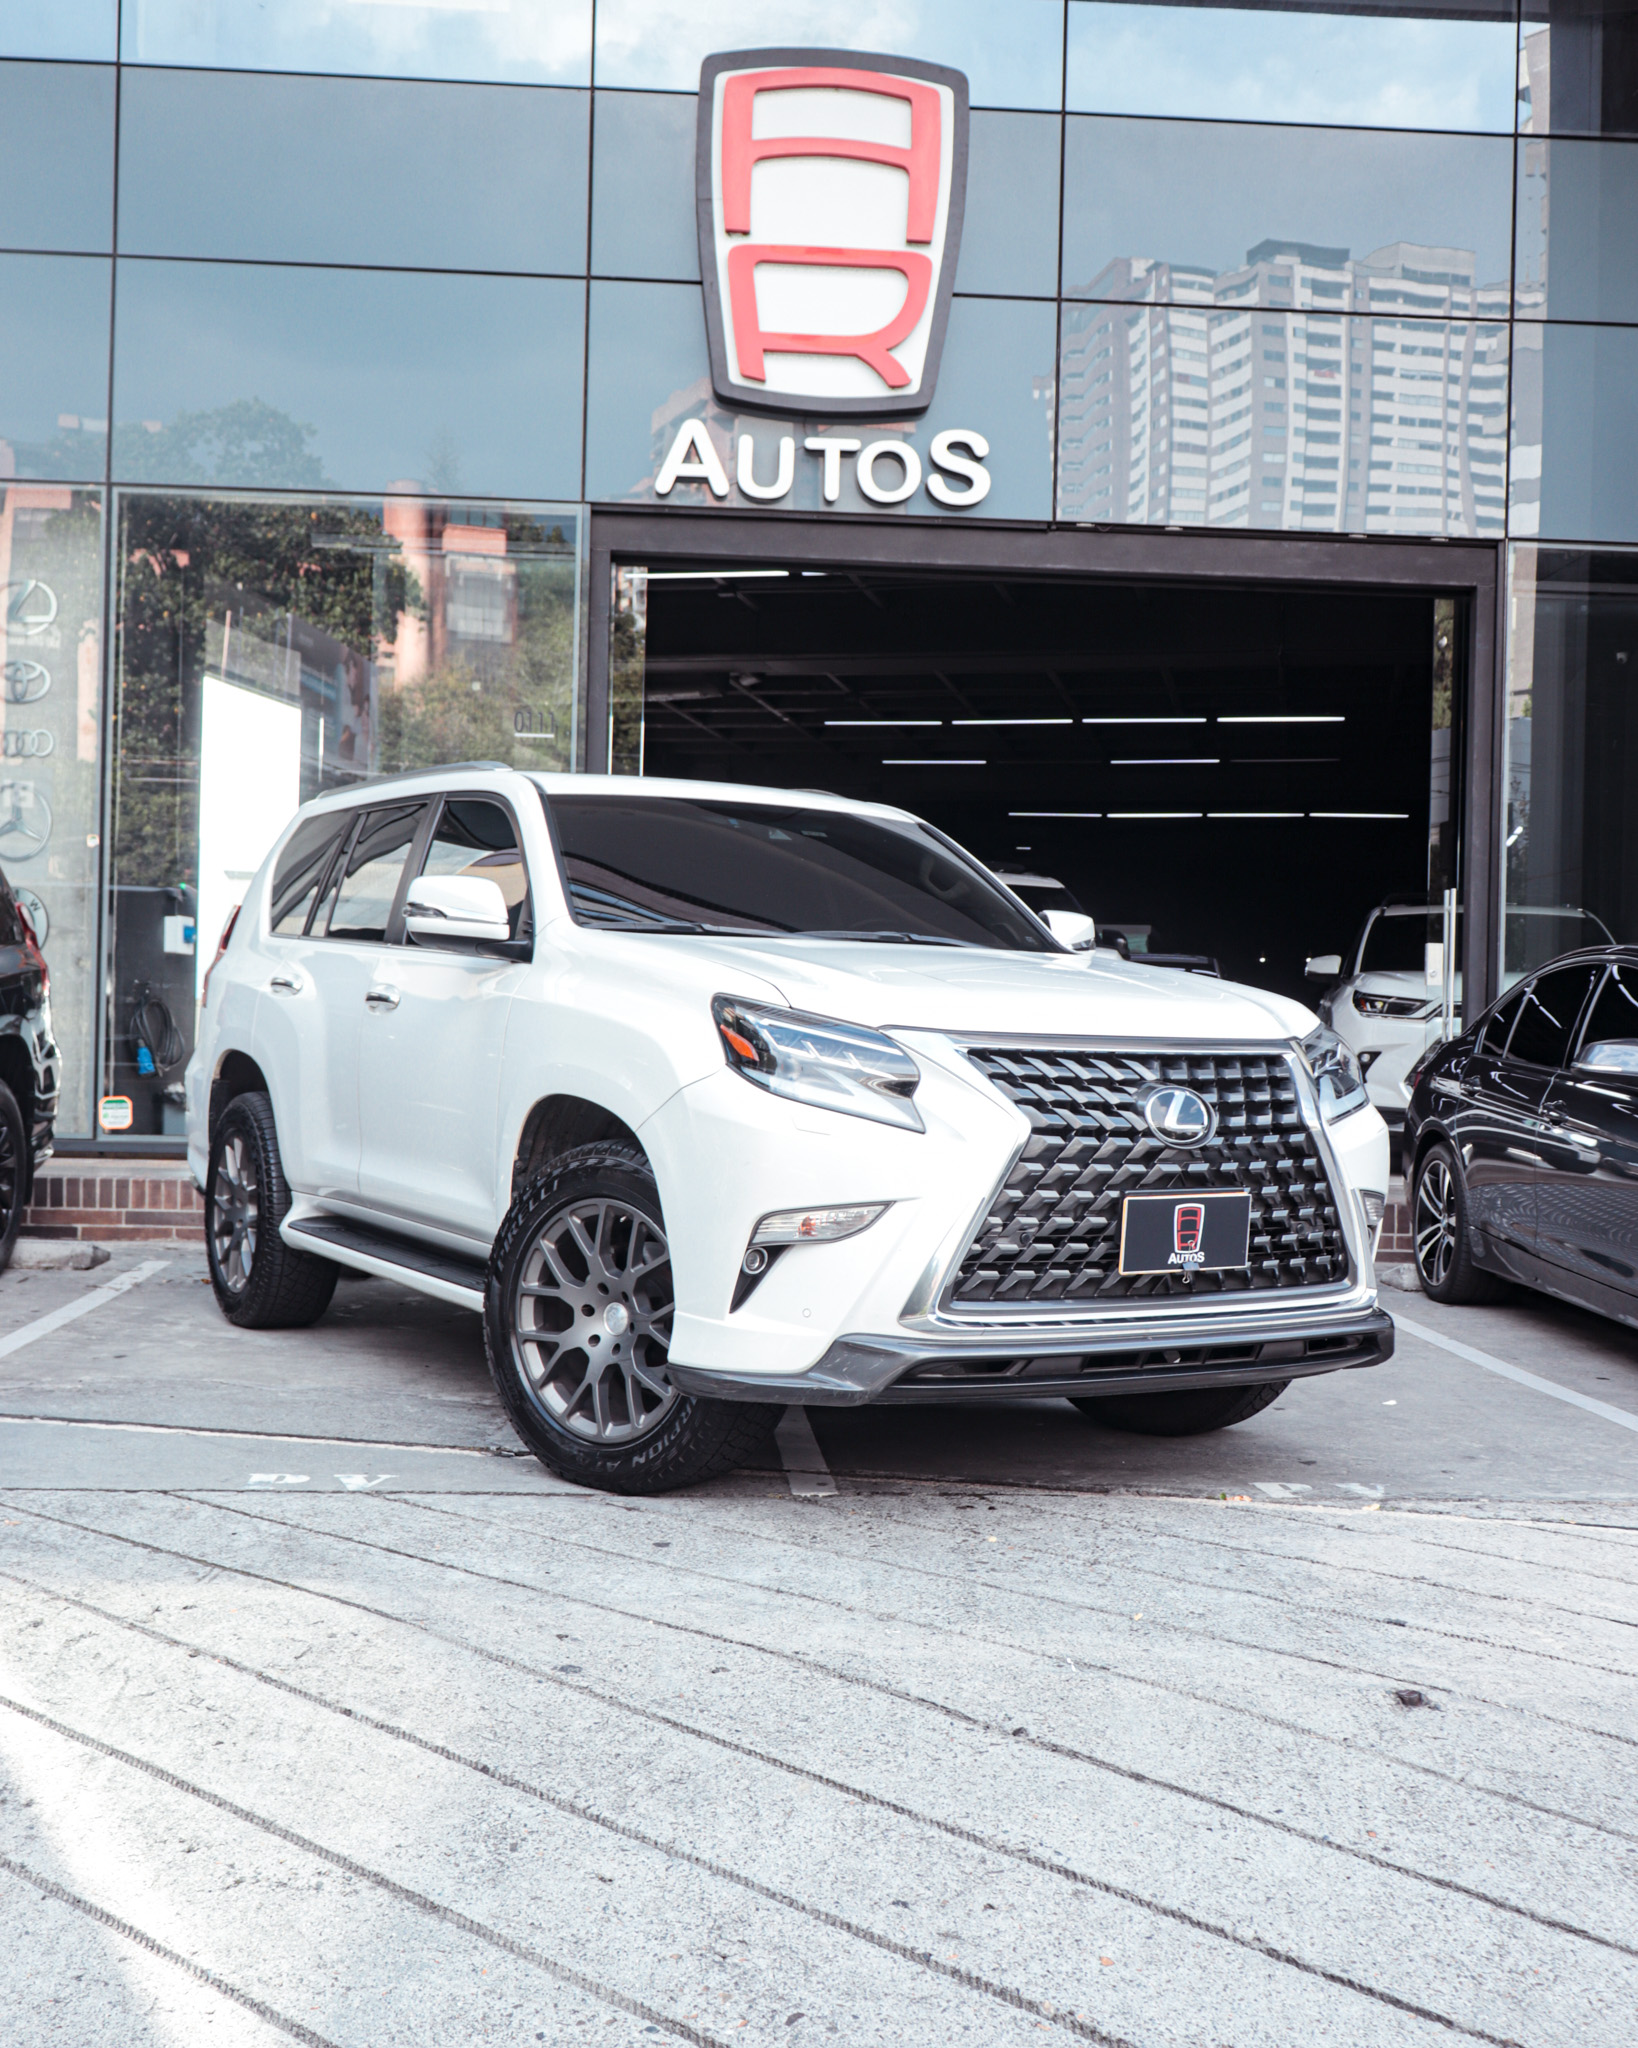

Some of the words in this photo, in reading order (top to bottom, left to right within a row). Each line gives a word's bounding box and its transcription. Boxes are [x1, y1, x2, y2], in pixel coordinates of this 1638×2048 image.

[654, 418, 991, 507] AUTOS
[1167, 1251, 1205, 1265] AUTOS
[632, 1396, 698, 1468] RPION
